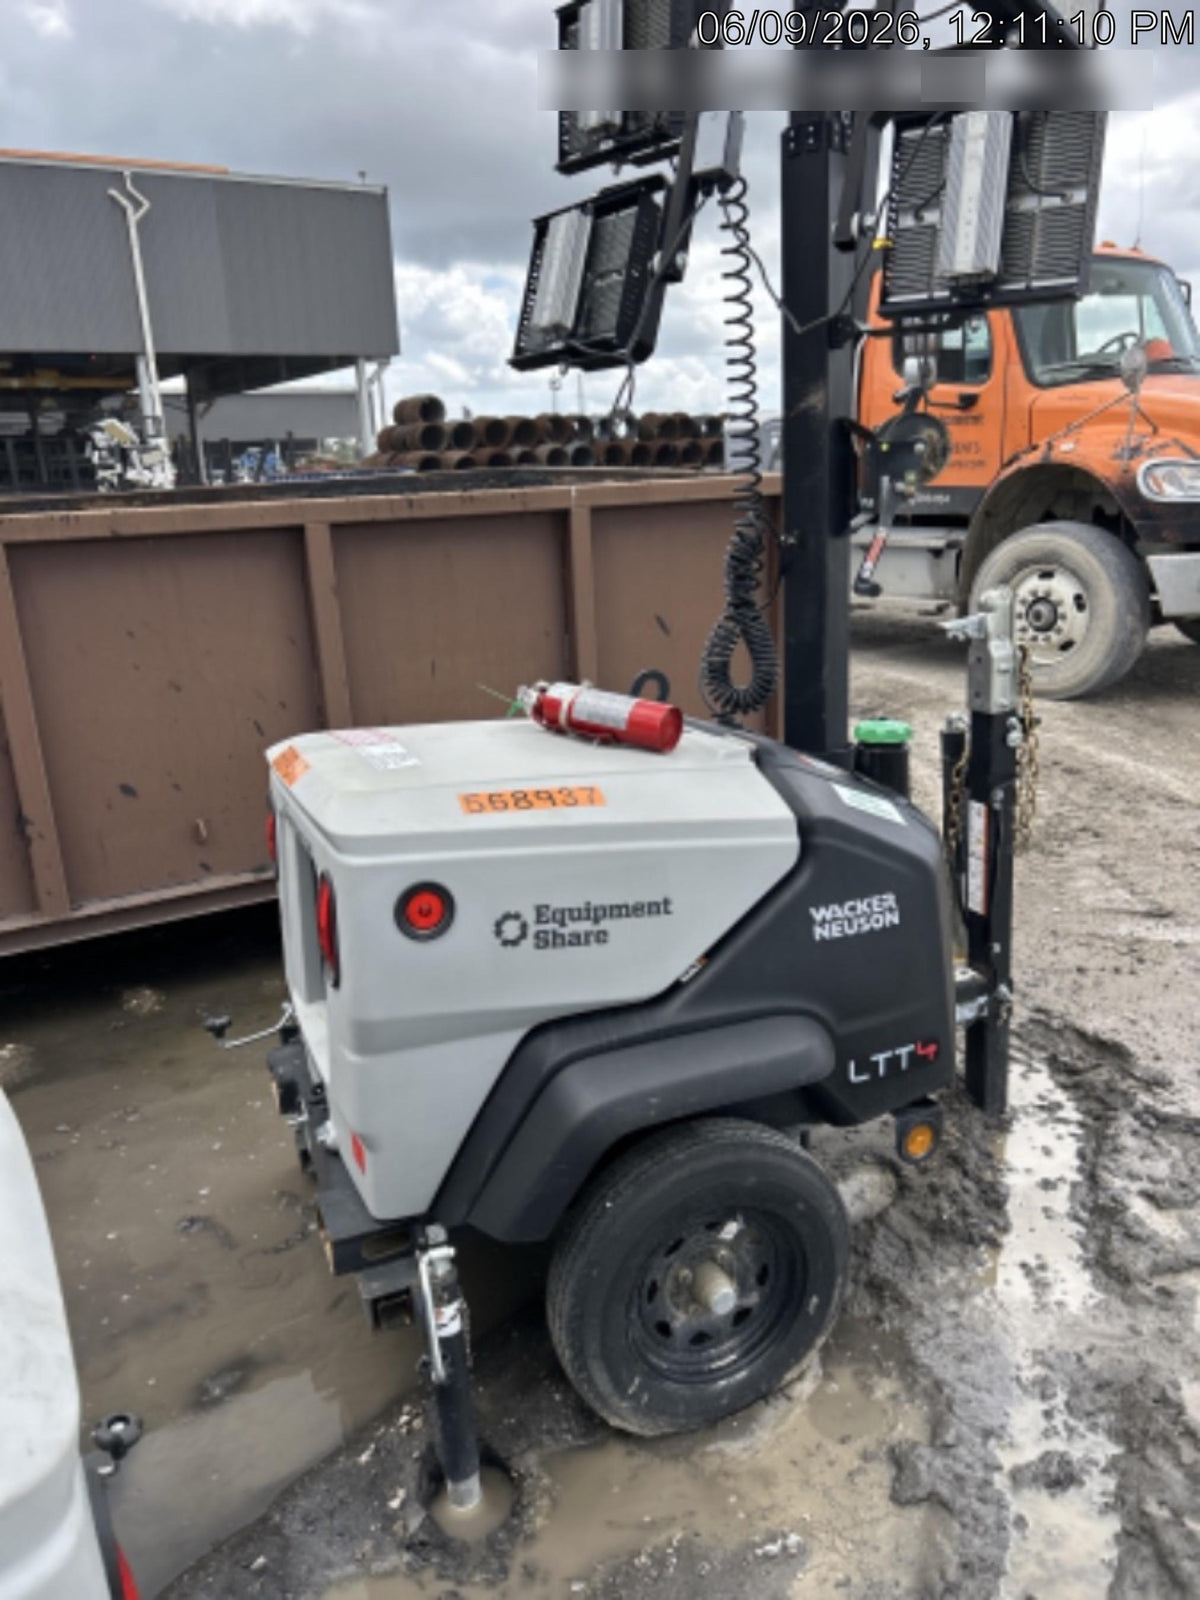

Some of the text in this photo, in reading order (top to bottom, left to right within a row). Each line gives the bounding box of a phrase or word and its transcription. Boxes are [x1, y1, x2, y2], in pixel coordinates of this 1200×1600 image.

[534, 897, 673, 928] Equipment
[809, 892, 897, 923] WACKER
[534, 929, 609, 950] Share
[813, 909, 900, 941] NEUSON
[849, 1041, 938, 1084] LTT4
